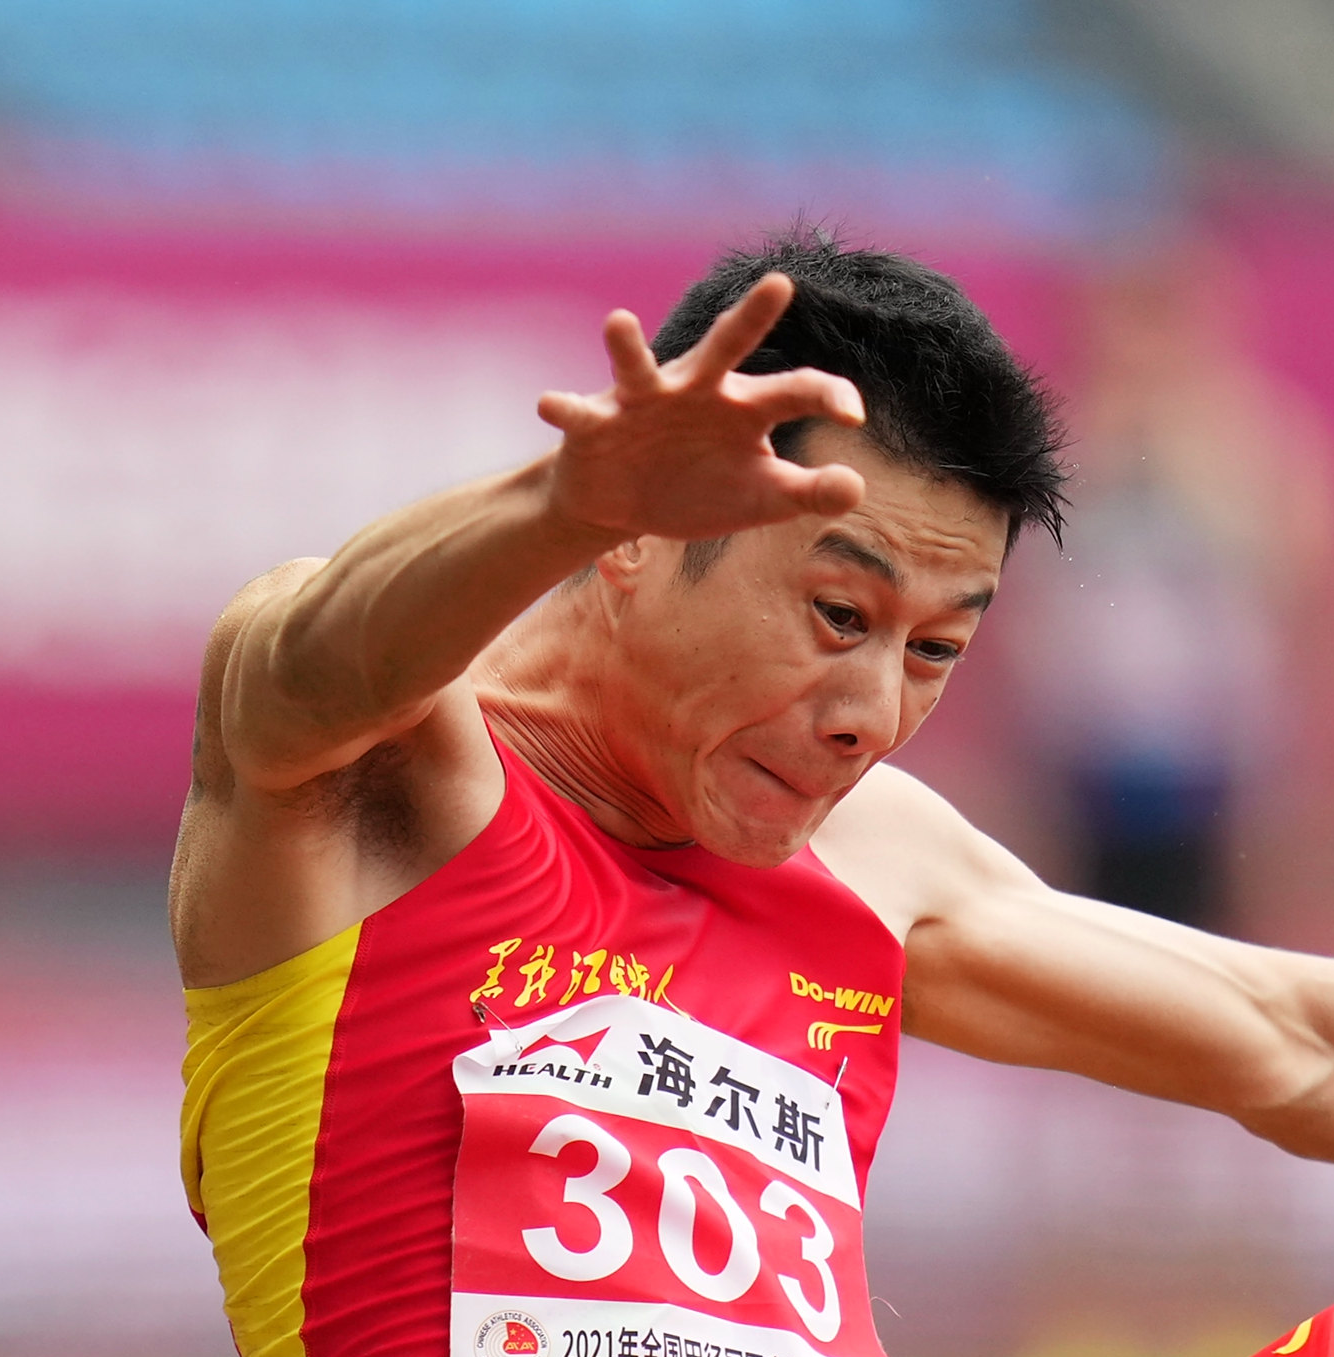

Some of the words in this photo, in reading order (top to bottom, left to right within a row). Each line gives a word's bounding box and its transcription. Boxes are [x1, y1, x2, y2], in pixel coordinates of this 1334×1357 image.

[493, 1063, 612, 1089] HEALTH
[637, 1033, 824, 1172] 海尔斯
[521, 1114, 842, 1343] 303
[477, 1323, 491, 1348] CHINESE
[490, 1312, 522, 1325] ATHLETICS
[523, 1317, 547, 1348] ASSOCIATION
